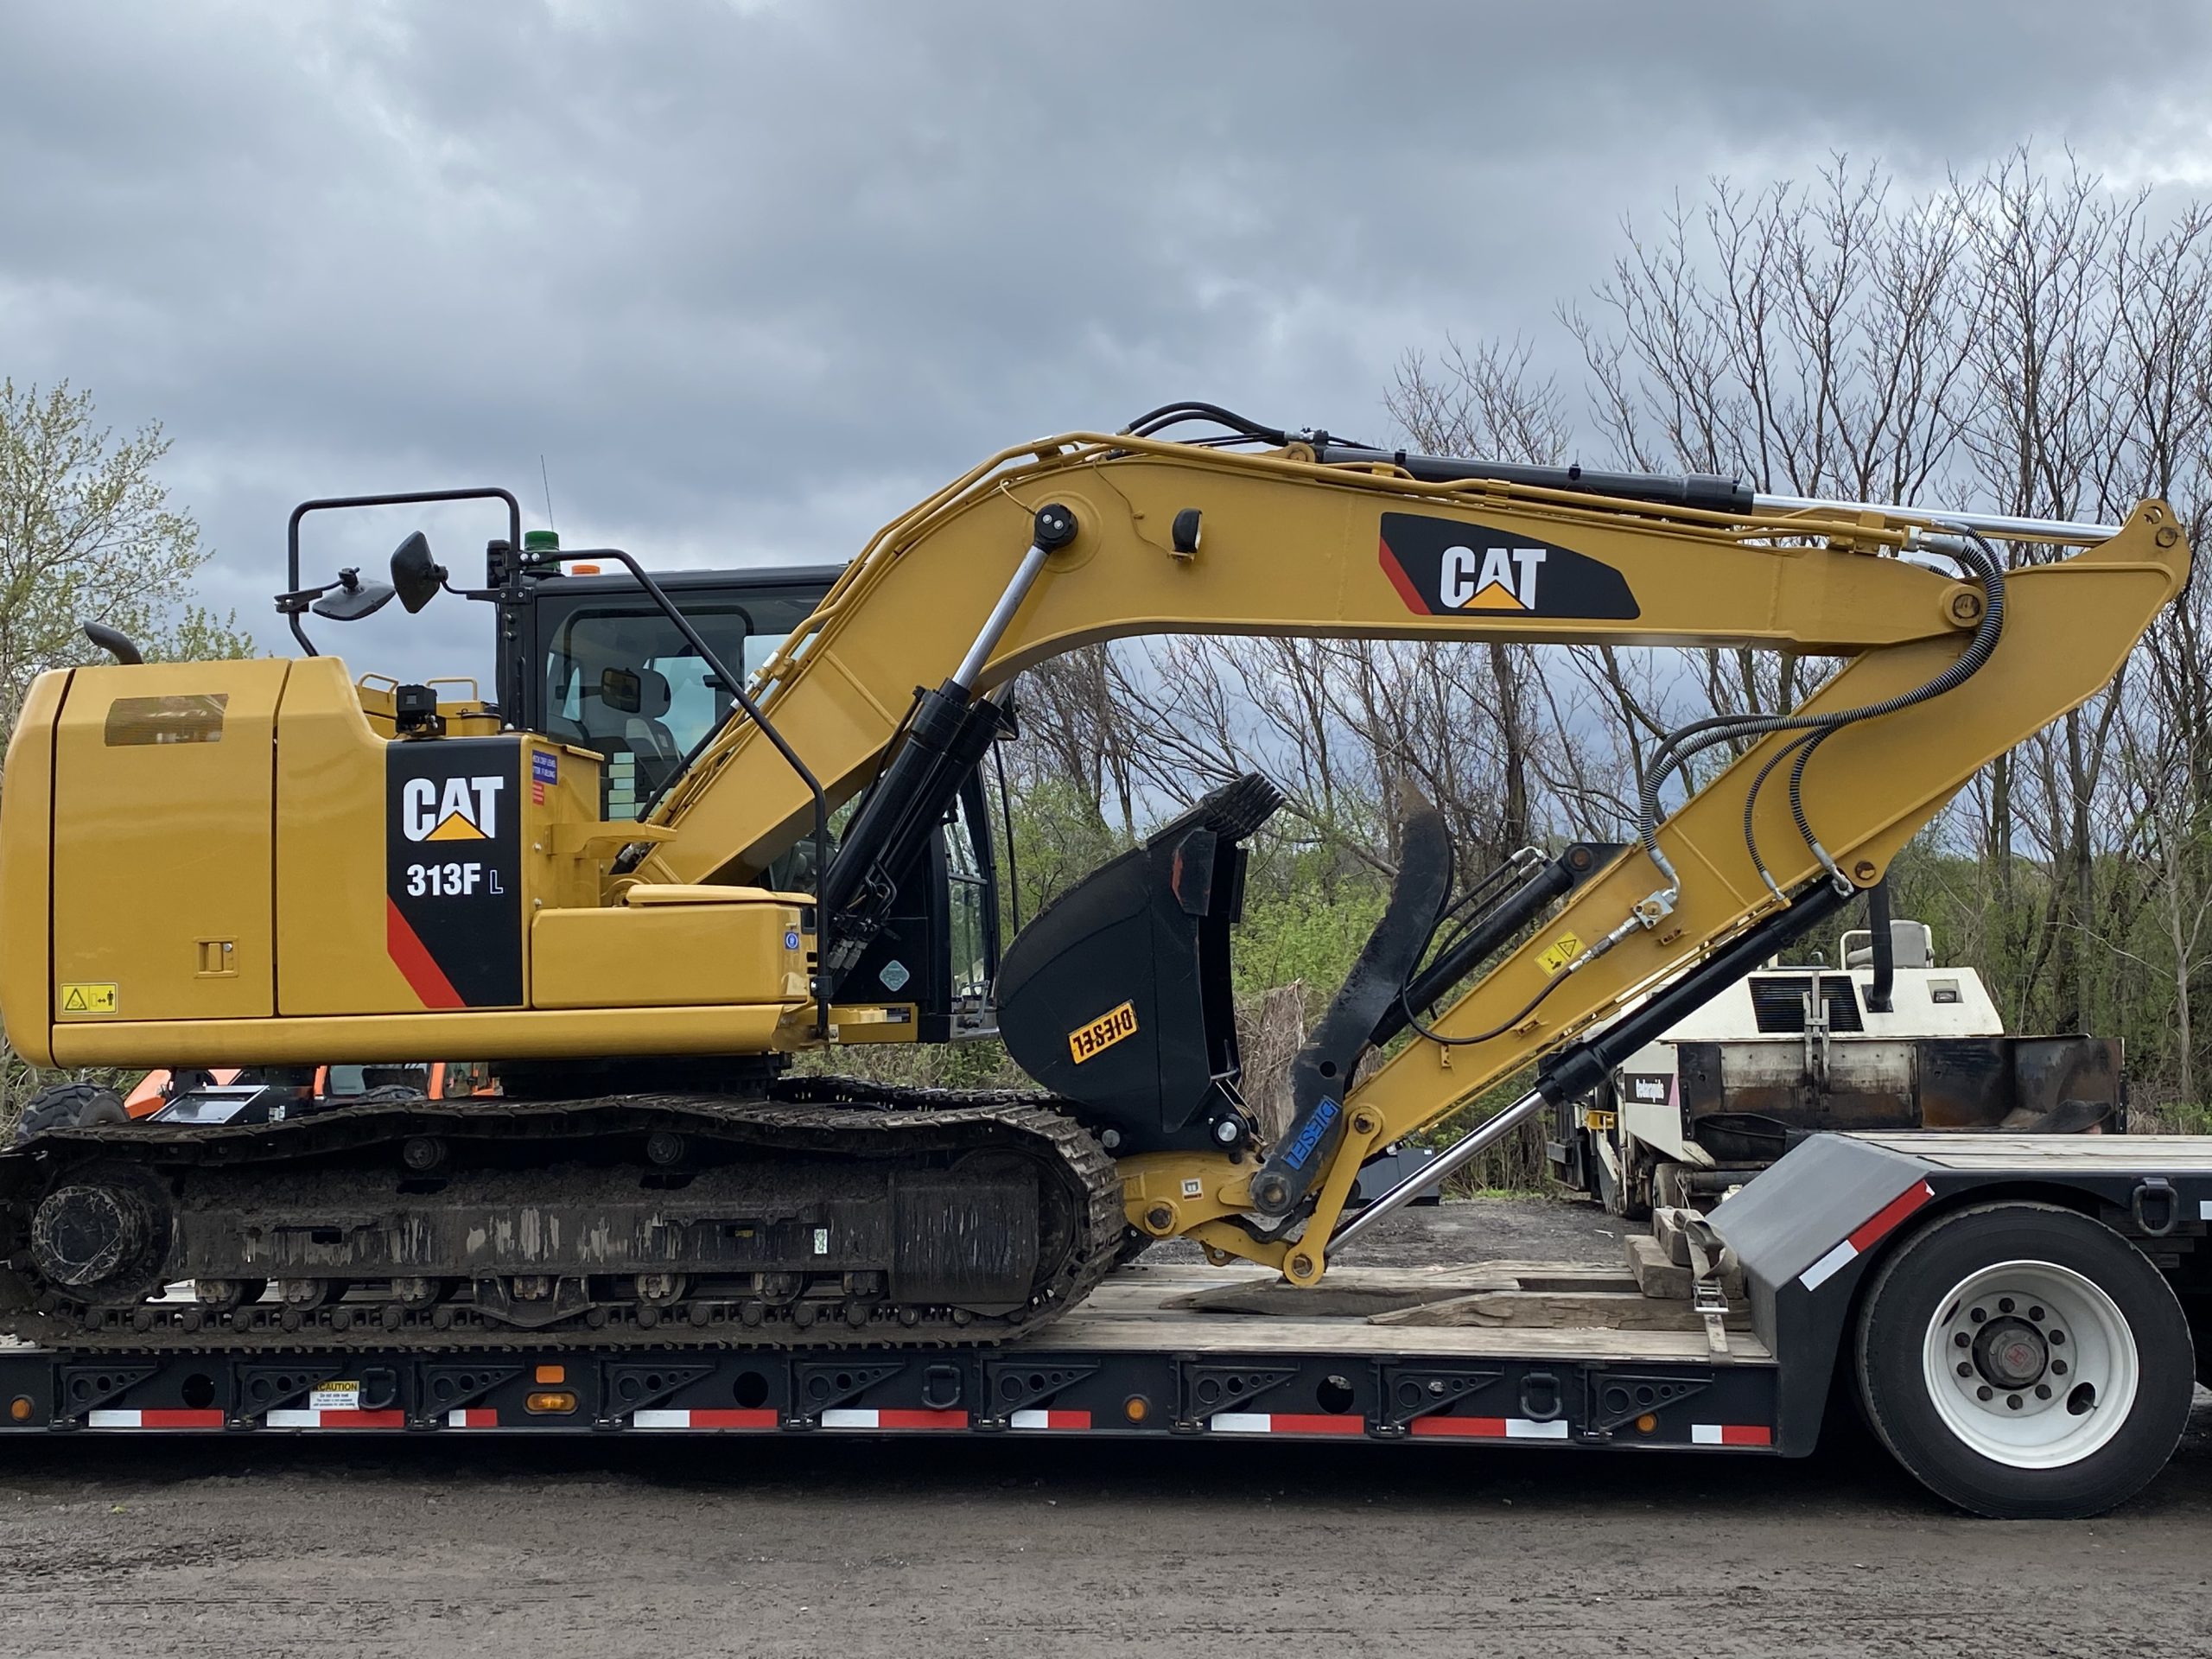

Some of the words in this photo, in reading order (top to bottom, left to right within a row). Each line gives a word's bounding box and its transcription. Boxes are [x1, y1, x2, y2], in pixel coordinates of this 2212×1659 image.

[1440, 545, 1547, 610] CAT
[403, 776, 505, 842] CAT
[406, 862, 481, 897] 313F
[489, 869, 505, 895] L
[1072, 1007, 1133, 1058] DIESEL
[1285, 1100, 1337, 1164] DIESEL
[319, 1382, 358, 1392] CAUTION
